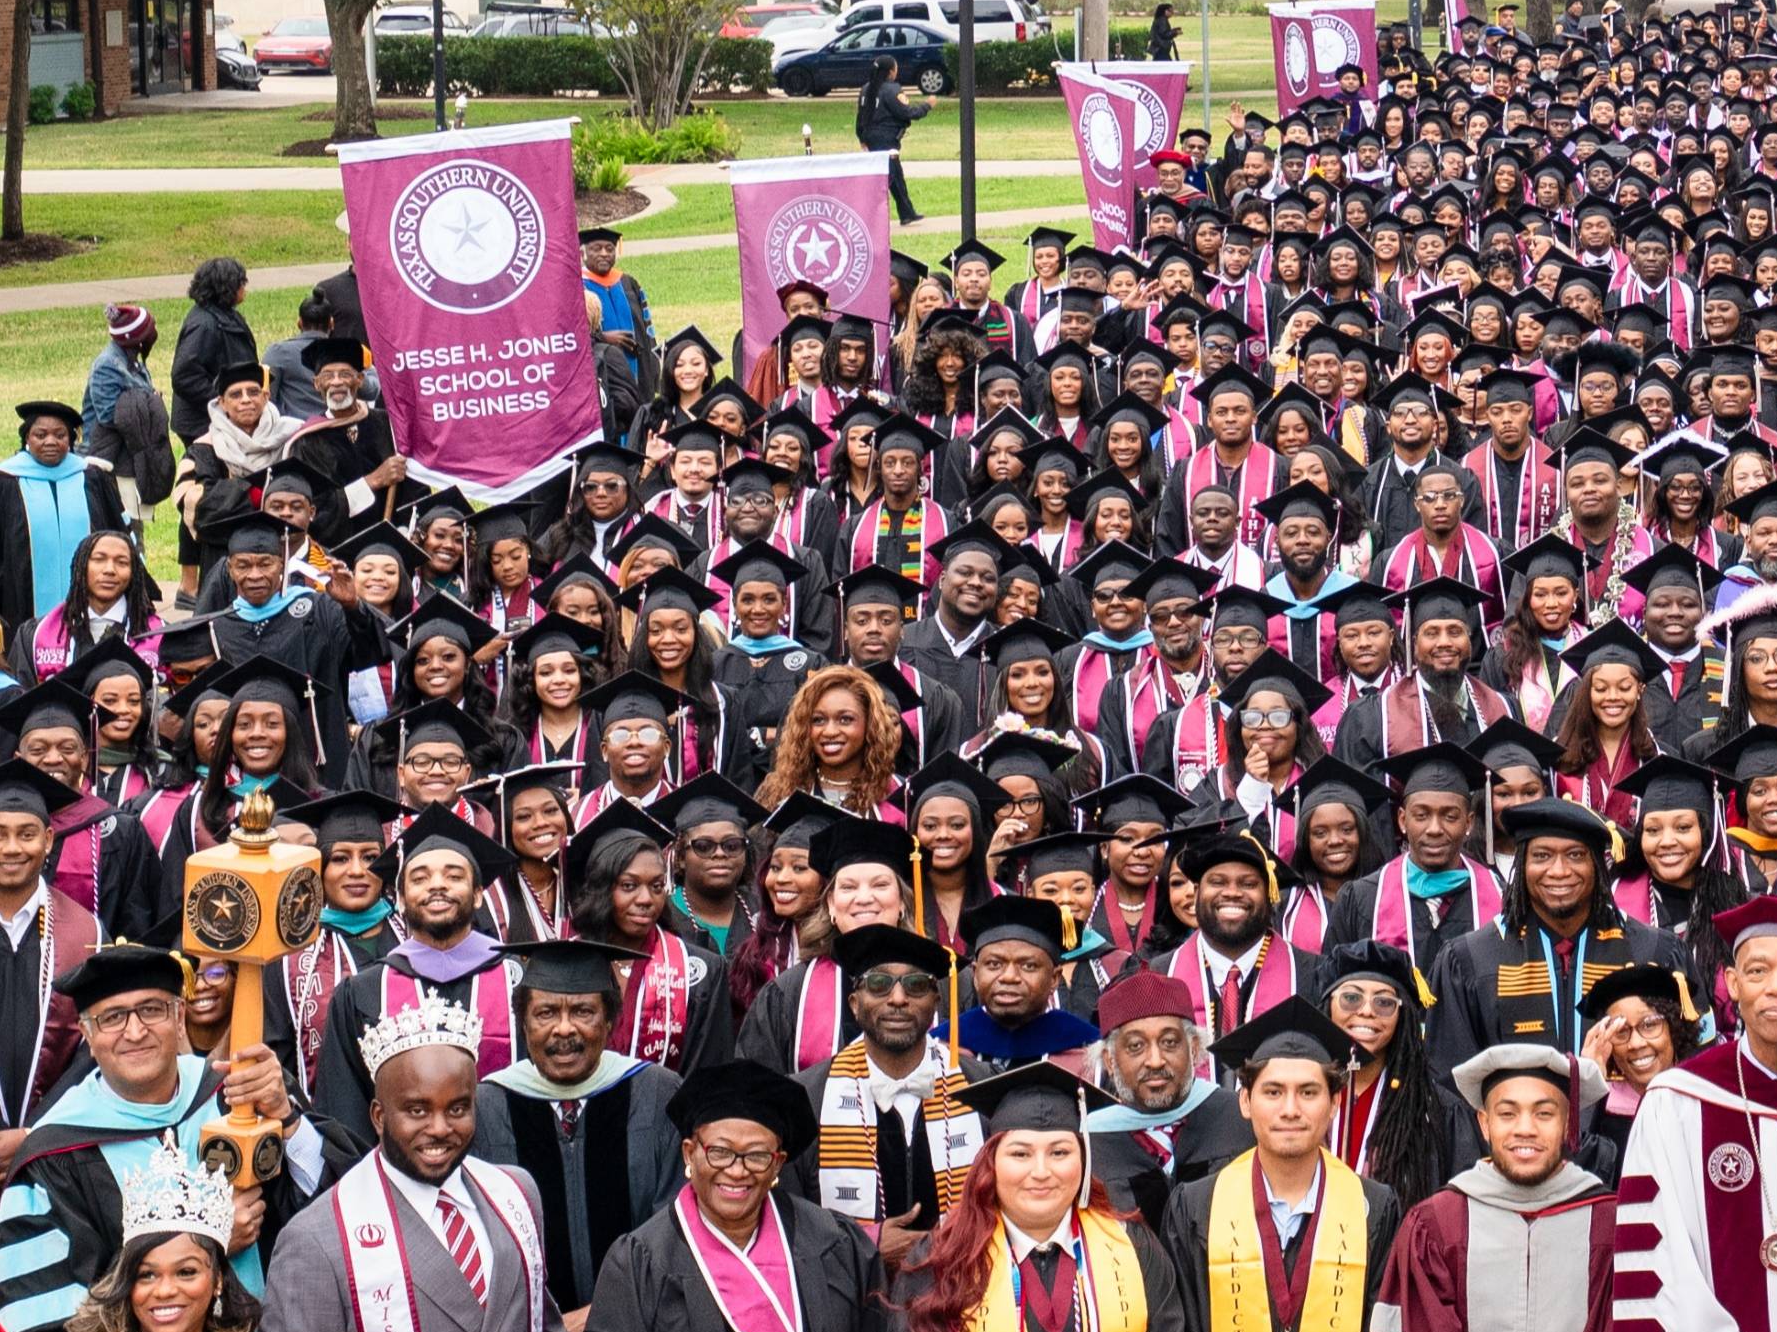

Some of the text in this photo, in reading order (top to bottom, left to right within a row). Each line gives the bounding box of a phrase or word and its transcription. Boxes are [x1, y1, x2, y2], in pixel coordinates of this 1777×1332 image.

[1312, 20, 1337, 31] HERN
[399, 166, 539, 292] TEXAS SOUTHERN UNIVERSITY
[770, 202, 870, 294] EXAS SOUTHERN UNIVERSITY
[392, 333, 577, 372] JESSE H. JONES
[419, 363, 556, 396] SCHOOL OF
[433, 391, 551, 422] BUSINESS
